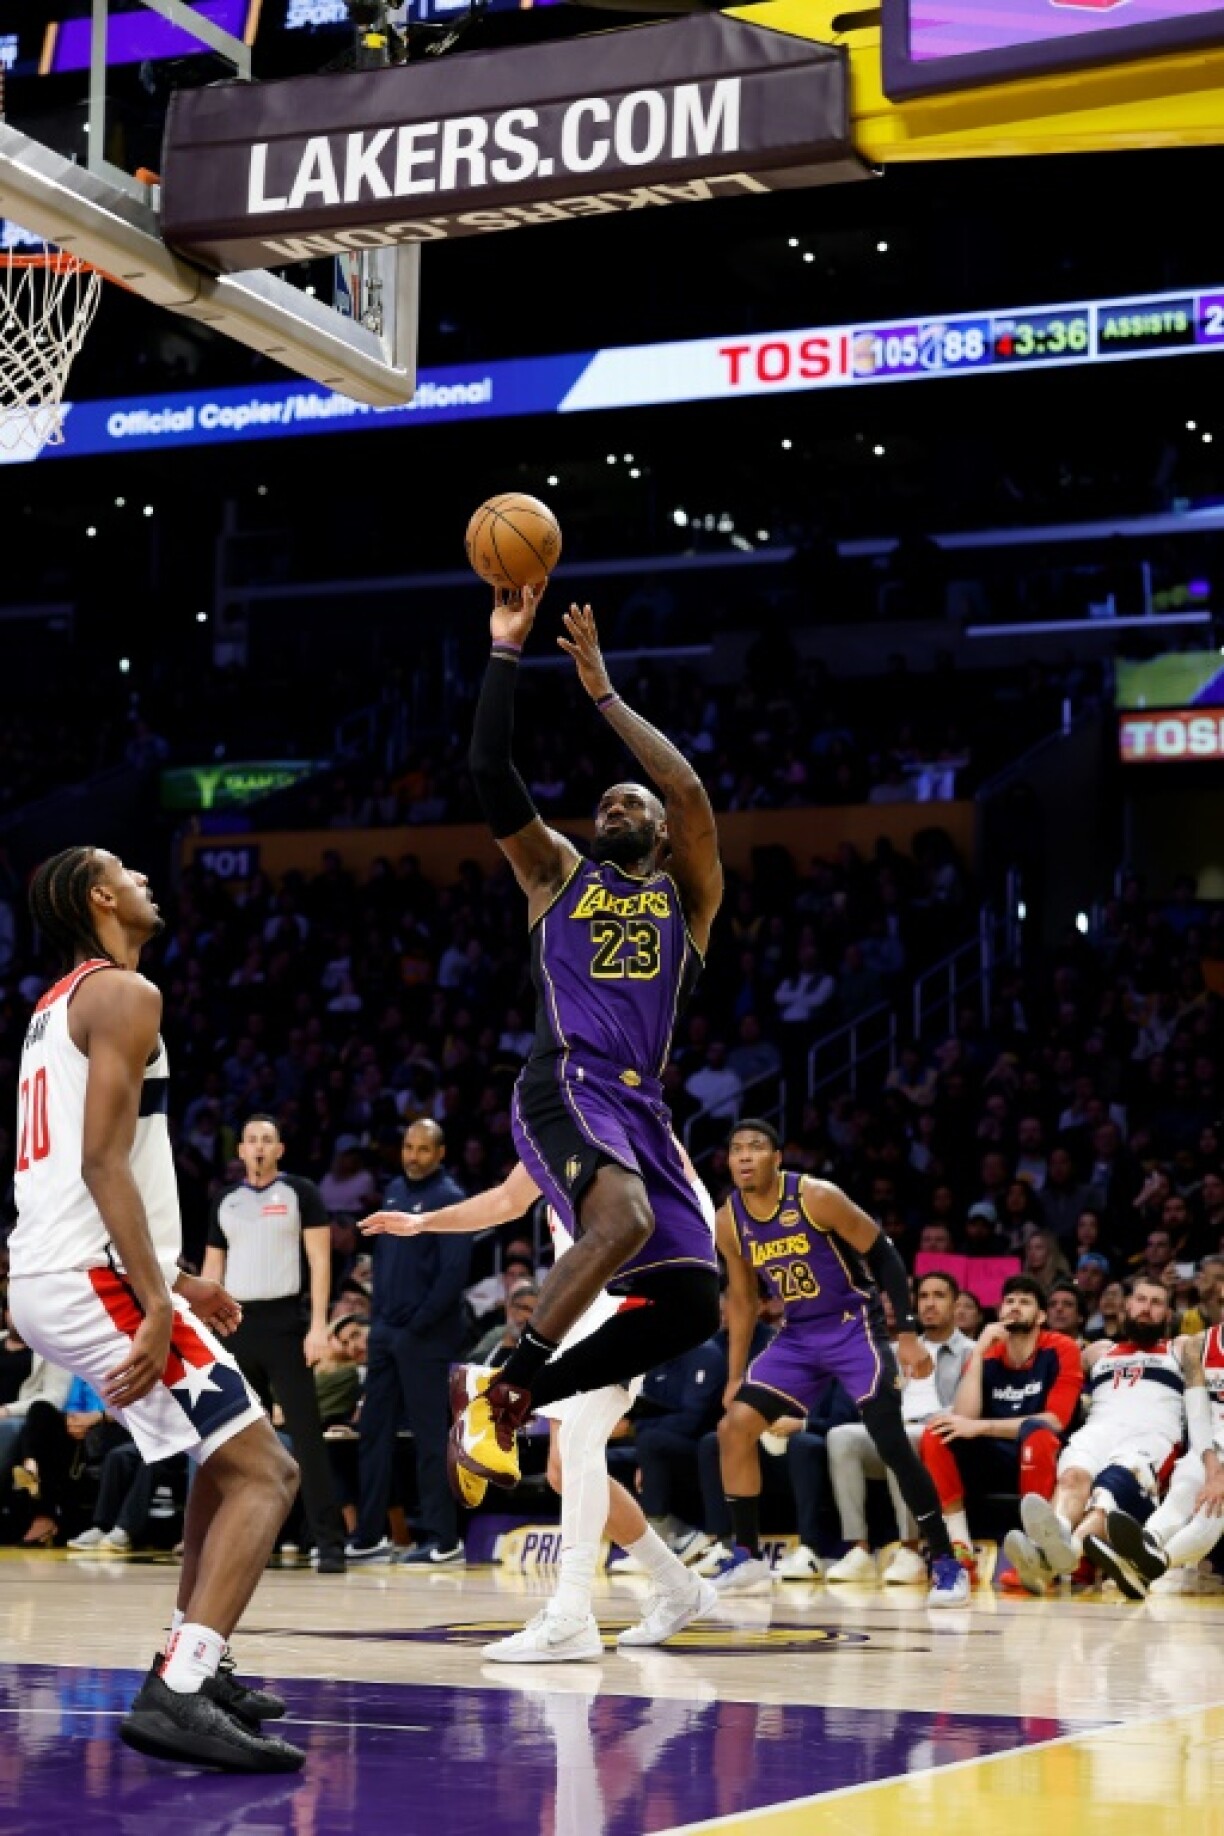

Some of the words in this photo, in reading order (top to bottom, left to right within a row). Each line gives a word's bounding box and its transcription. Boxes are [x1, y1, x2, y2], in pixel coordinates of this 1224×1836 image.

[247, 77, 742, 215] LAKERS.COM
[261, 172, 773, 261] LAKERS.COM
[1015, 317, 1088, 357] 3:36
[1102, 309, 1189, 341] ASSISTS
[719, 335, 848, 387] TOS
[871, 333, 918, 370] 105
[943, 327, 986, 363] 88
[107, 405, 195, 437] Official
[1122, 717, 1224, 757] TOS
[568, 883, 672, 919] LAKERS
[590, 920, 661, 979] 23
[748, 1232, 811, 1268] LAKERS
[765, 1260, 821, 1301] 28
[1113, 1365, 1146, 1390] 17
[520, 1531, 563, 1566] PRI
